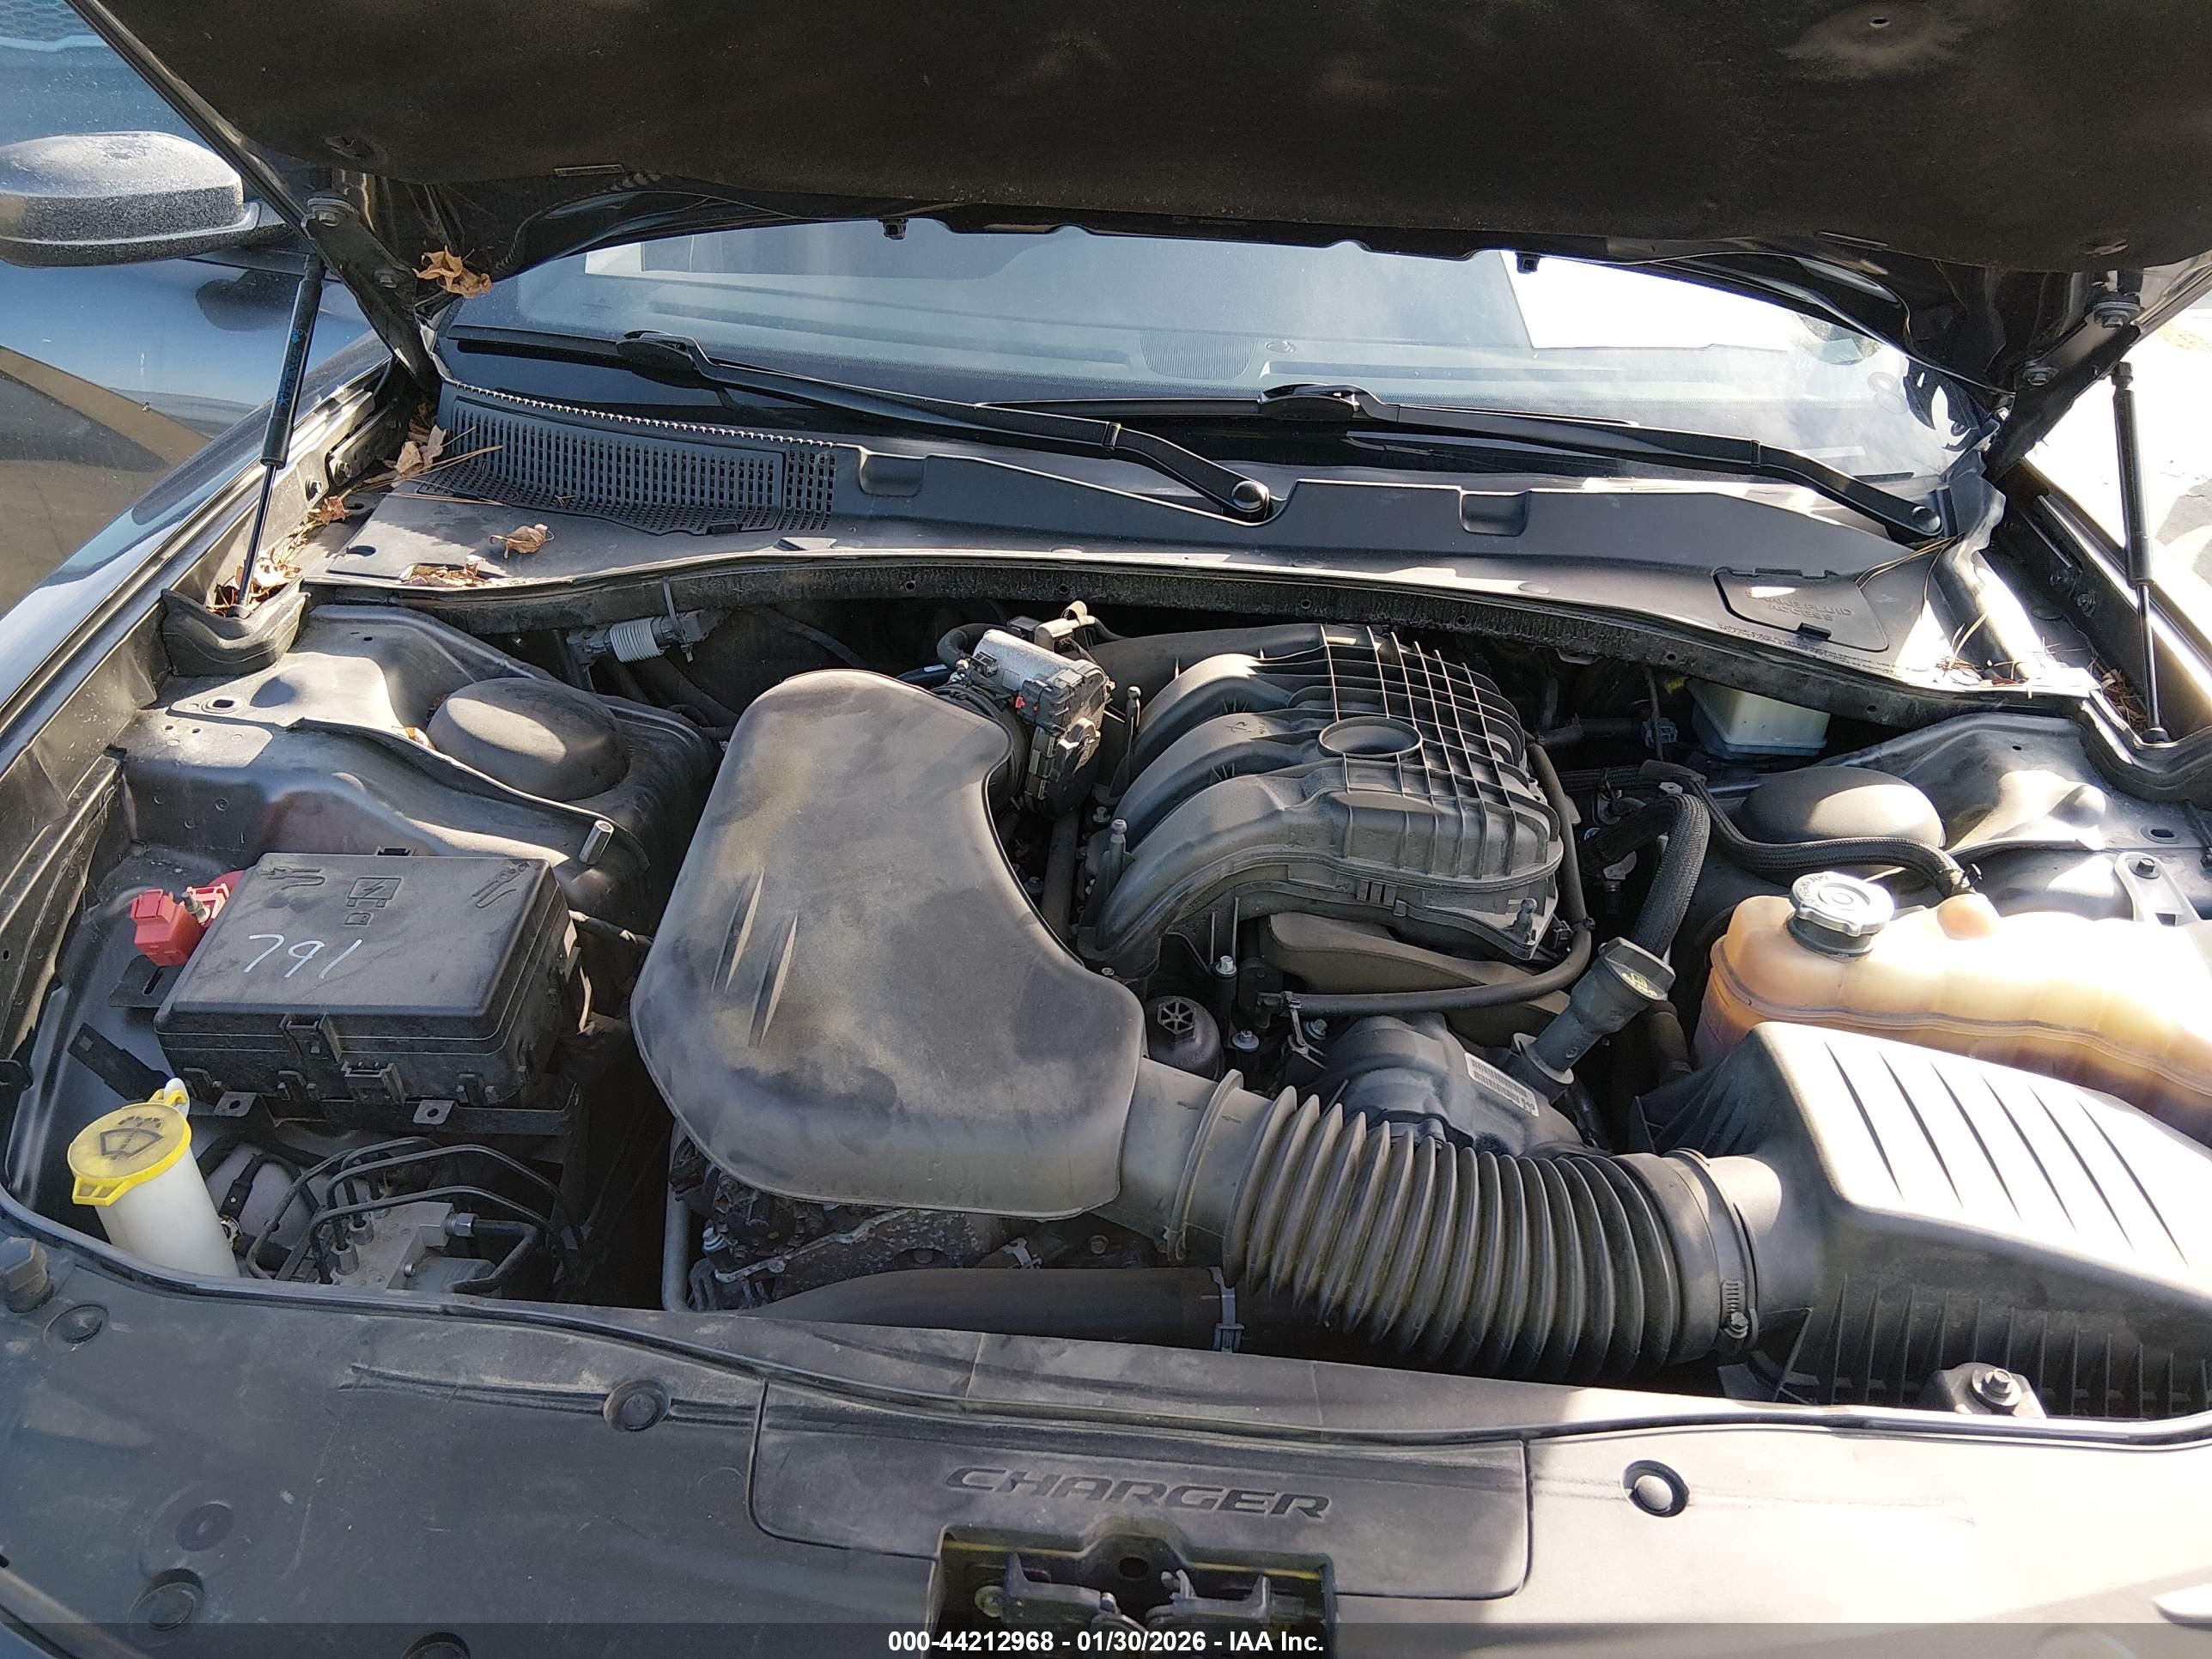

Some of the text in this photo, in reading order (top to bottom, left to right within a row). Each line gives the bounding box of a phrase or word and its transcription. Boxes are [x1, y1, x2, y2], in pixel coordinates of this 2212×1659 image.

[1769, 604, 1833, 622] ACCESS
[1804, 604, 1853, 616] FLUID
[243, 933, 362, 979] 791
[945, 1467, 1331, 1520] CHARGER
